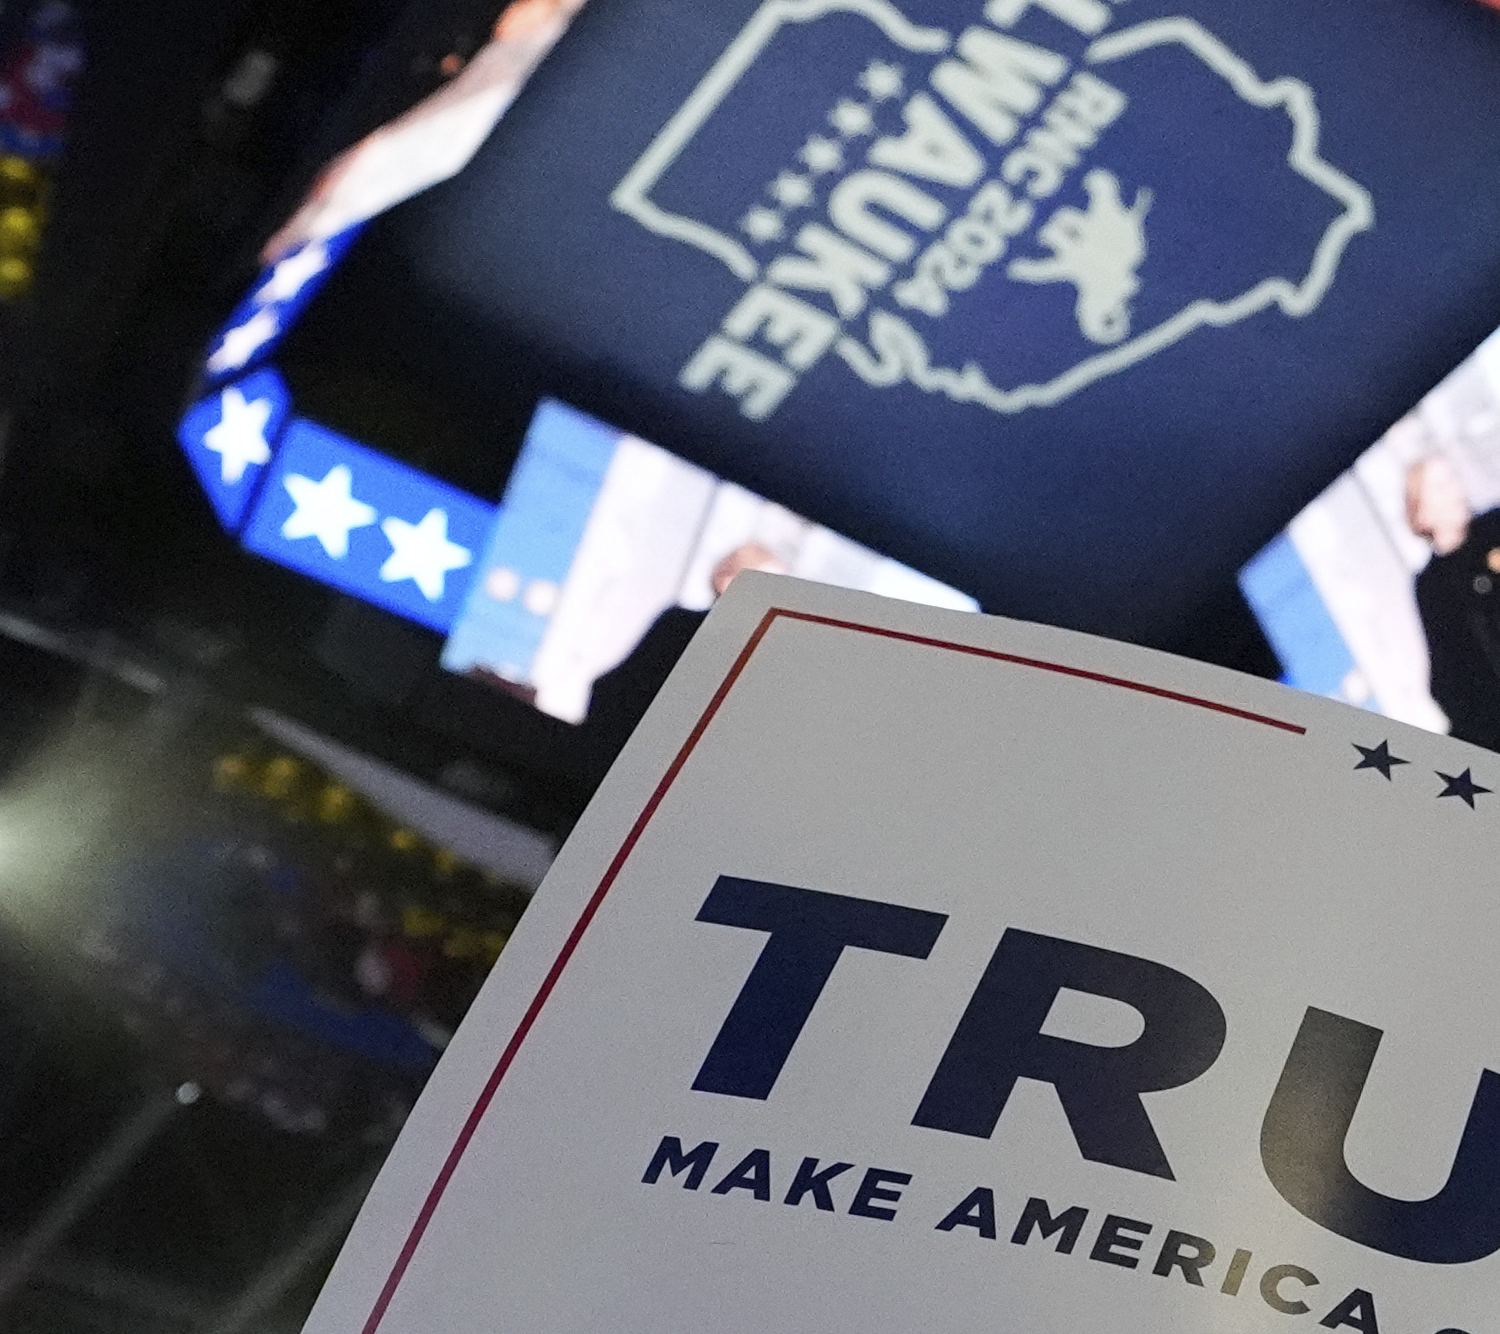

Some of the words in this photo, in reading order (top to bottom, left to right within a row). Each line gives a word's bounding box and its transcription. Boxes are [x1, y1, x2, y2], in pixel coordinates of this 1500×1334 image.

[1000, 70, 1130, 199] RNC
[893, 179, 1036, 317] 2024
[641, 1135, 912, 1222] MAKE
